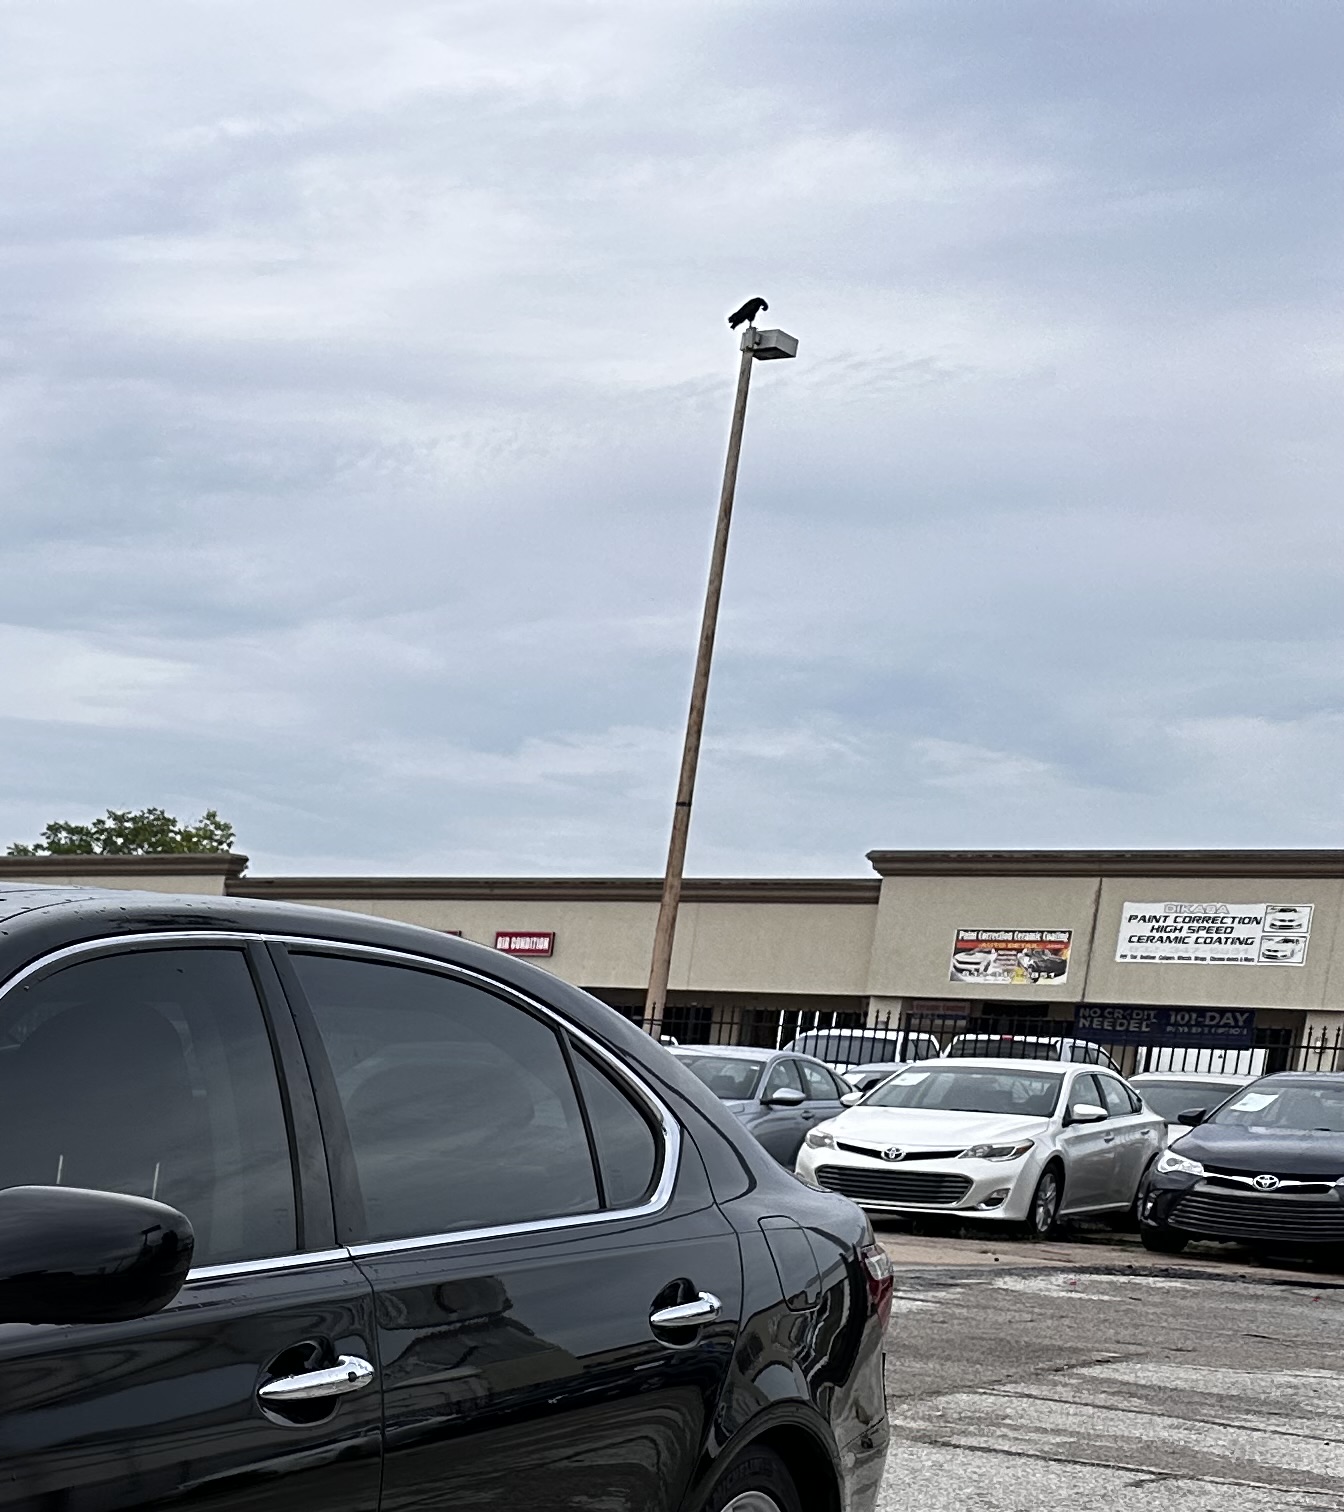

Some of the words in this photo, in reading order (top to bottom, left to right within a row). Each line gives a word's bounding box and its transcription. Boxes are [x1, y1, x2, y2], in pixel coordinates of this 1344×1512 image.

[1127, 915, 1169, 924] PAINT
[1172, 915, 1263, 926] CORRECTION
[1150, 925, 1183, 934] HIGH
[1187, 925, 1234, 935] SPEED
[959, 930, 977, 940] Paint
[978, 930, 1013, 941] Correction
[1014, 931, 1042, 941] Ceramic
[1043, 931, 1069, 942] Coating
[1127, 935, 1190, 945] CERAMIC
[1193, 936, 1256, 946] COATING
[497, 936, 510, 949] AIR
[511, 936, 550, 950] CONDITION
[1079, 1008, 1100, 1017] NO
[1169, 1010, 1250, 1026] 101-DAY
